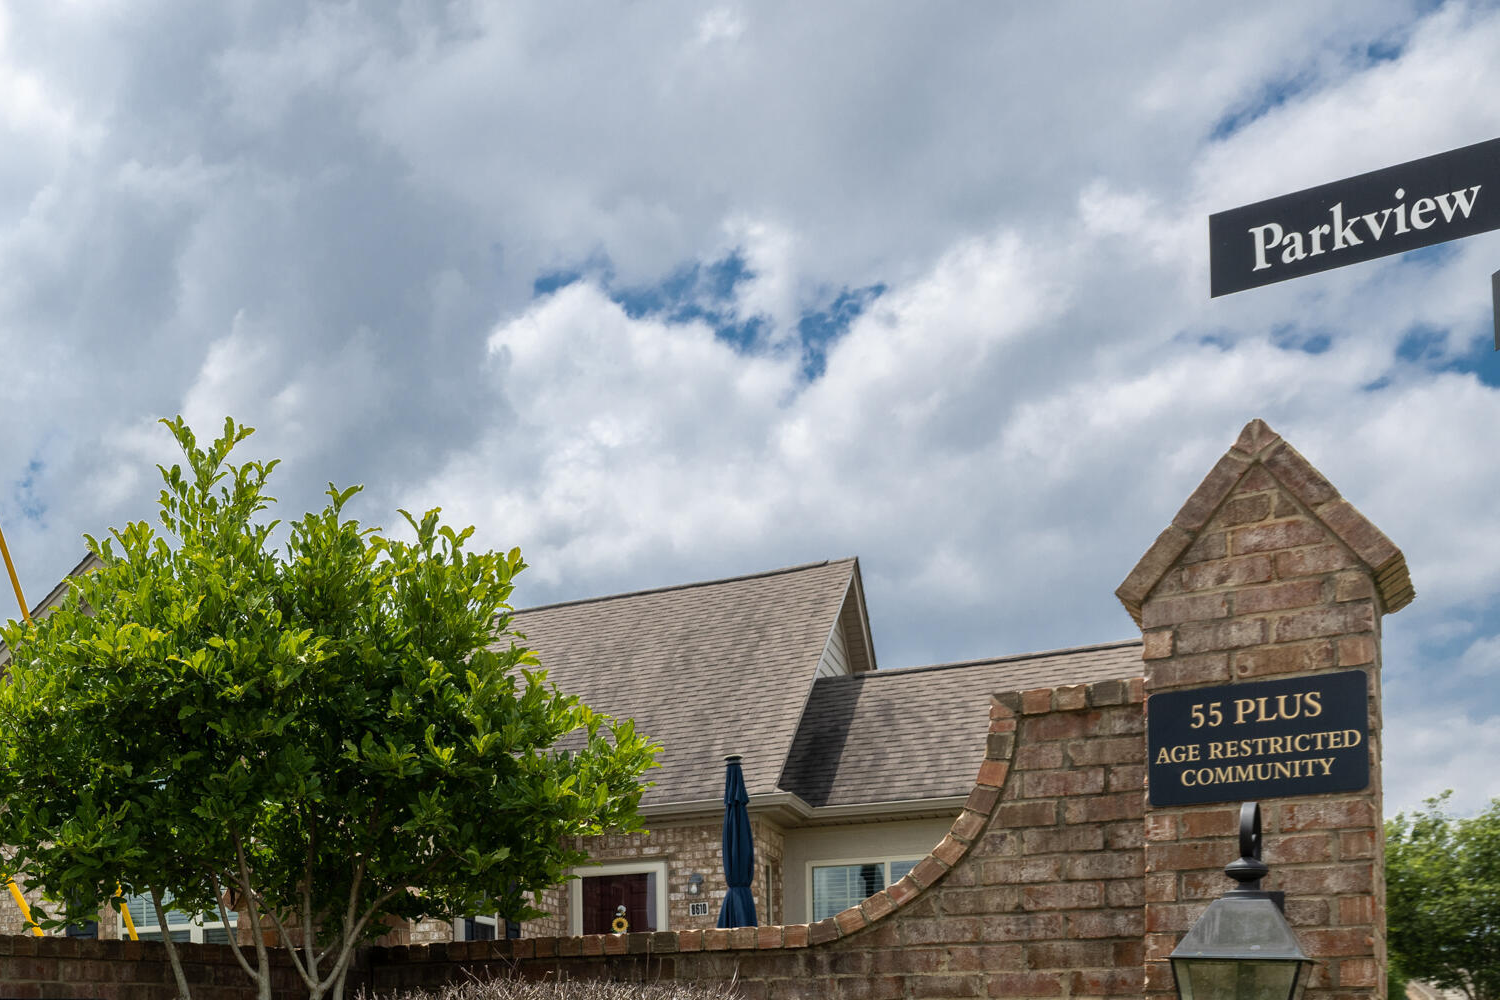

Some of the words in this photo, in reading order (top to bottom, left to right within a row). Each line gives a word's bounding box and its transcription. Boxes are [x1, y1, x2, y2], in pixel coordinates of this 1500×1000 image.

[1248, 185, 1481, 271] Parkview
[1190, 702, 1223, 729] 55
[1234, 691, 1322, 725] PLUS
[1155, 744, 1200, 765] AGE
[1208, 729, 1362, 760] RESTRICTED
[1180, 757, 1336, 787] COMMUNITY
